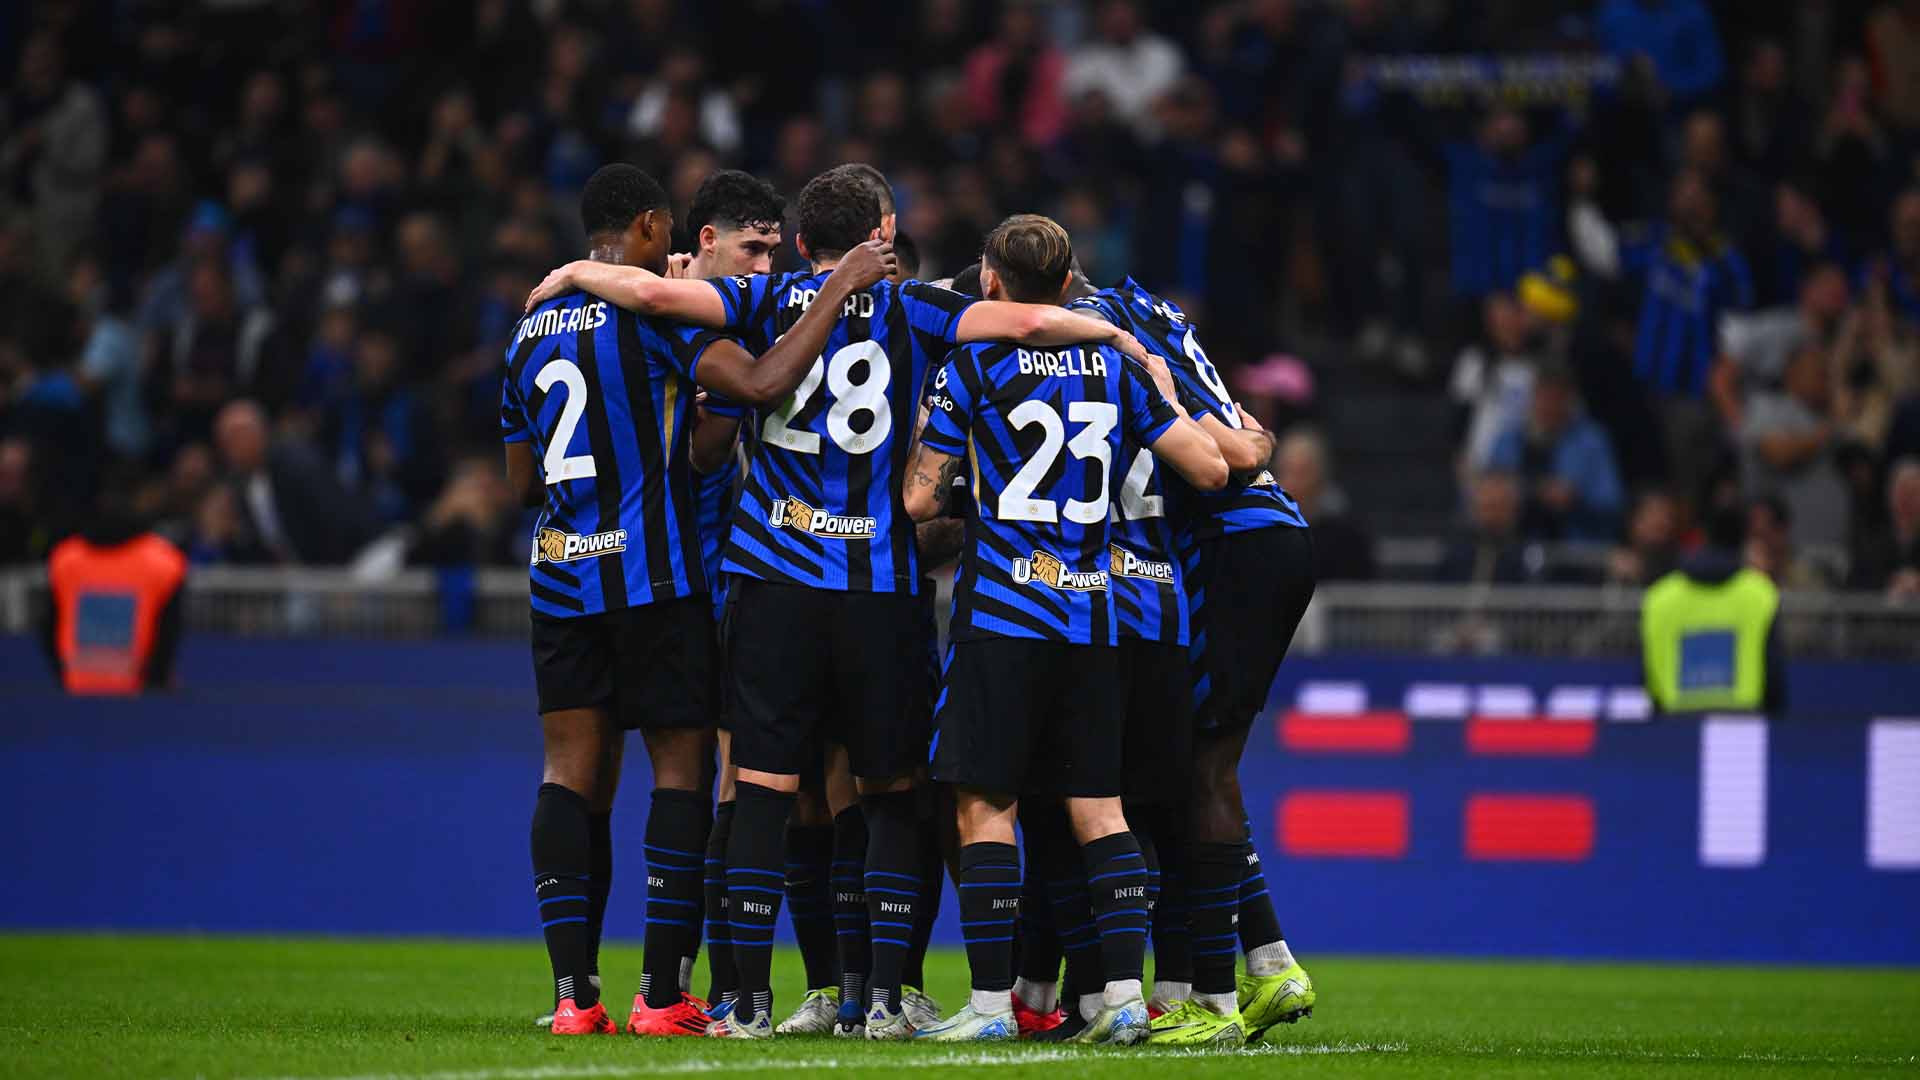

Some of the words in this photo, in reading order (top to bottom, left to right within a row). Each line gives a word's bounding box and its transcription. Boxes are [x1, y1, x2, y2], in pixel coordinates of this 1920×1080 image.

[788, 286, 875, 318] PARD
[517, 302, 608, 344] DUMFRIES
[1017, 348, 1107, 377] BARELLA
[761, 334, 892, 454] 28
[534, 358, 597, 486] 2
[997, 399, 1119, 524] 23
[809, 509, 876, 534] Power
[563, 529, 627, 561] Power
[1012, 557, 1032, 583] U
[1057, 563, 1107, 588] Power
[1123, 551, 1172, 579] Power
[880, 901, 911, 914] INTER
[992, 898, 1019, 909] INTER
[1114, 886, 1145, 899] INTER
[743, 901, 772, 915] INTER
